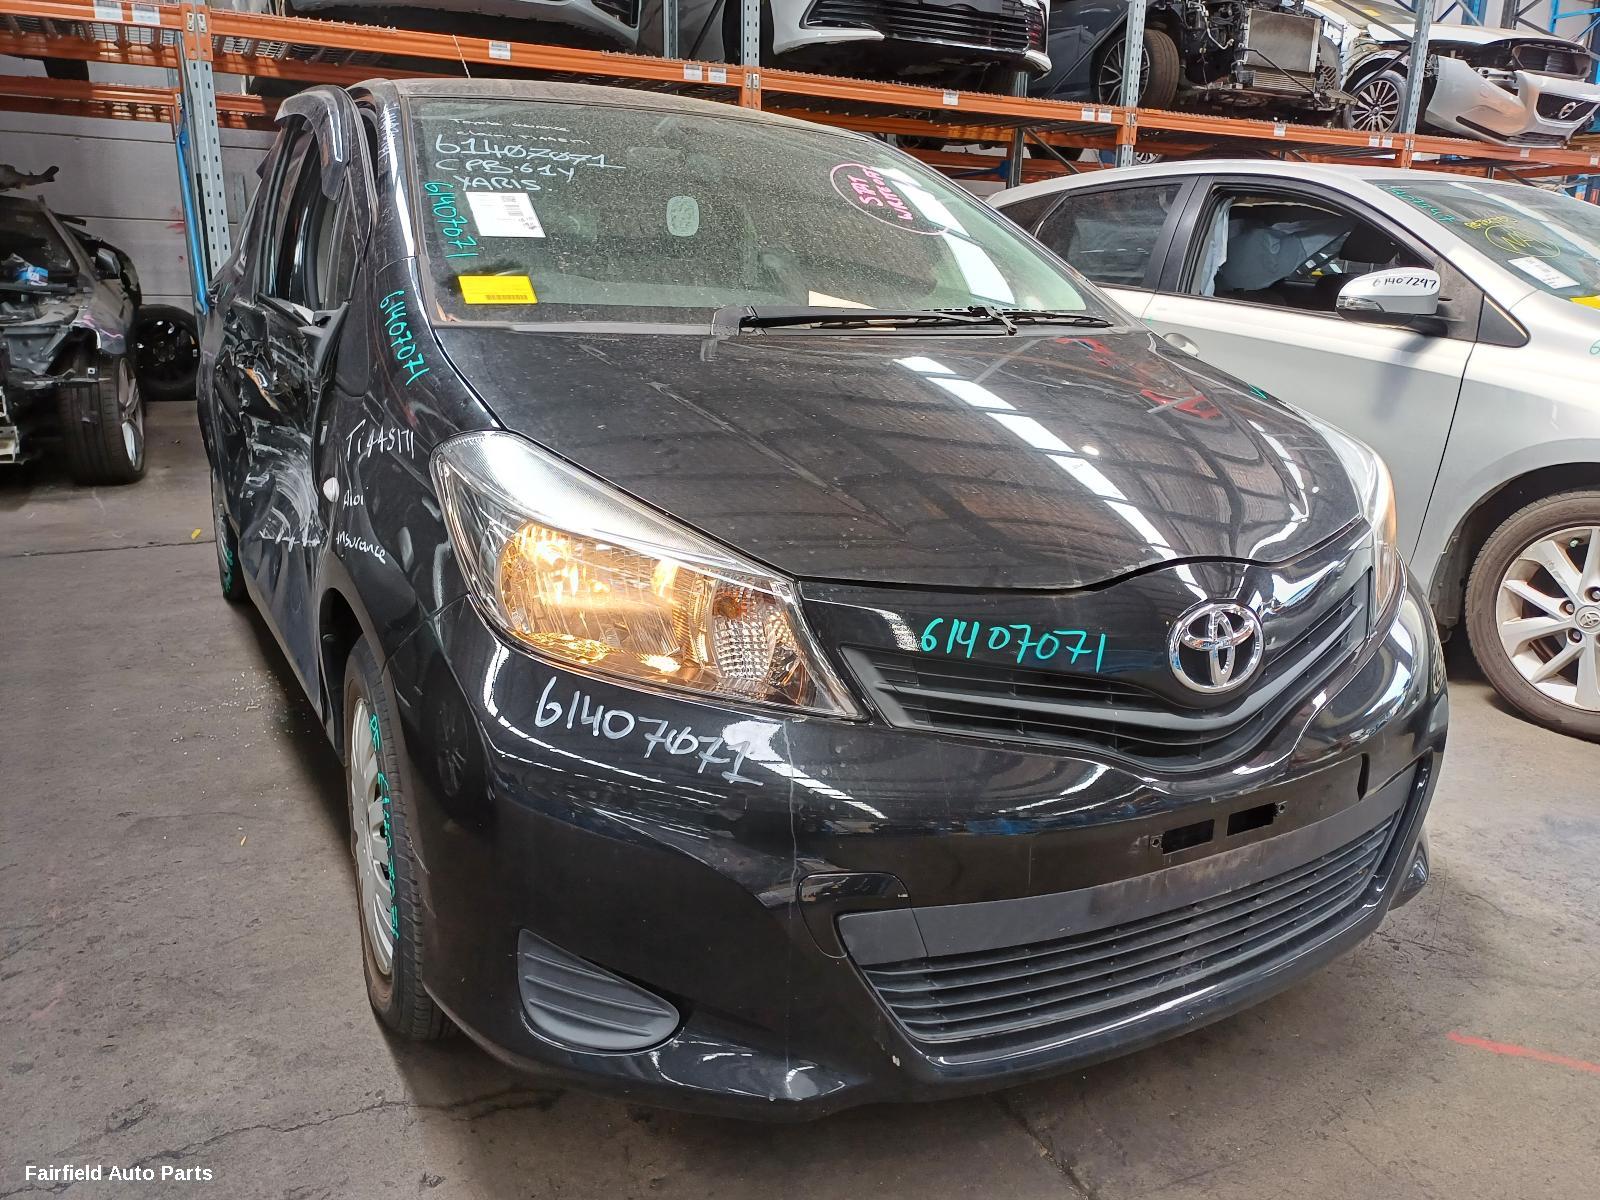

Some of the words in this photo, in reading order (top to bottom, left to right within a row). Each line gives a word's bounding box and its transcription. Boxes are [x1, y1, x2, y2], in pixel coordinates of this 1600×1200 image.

[435, 134, 626, 168] 61407071
[424, 182, 480, 258] 61407071
[379, 289, 430, 386] 61407071
